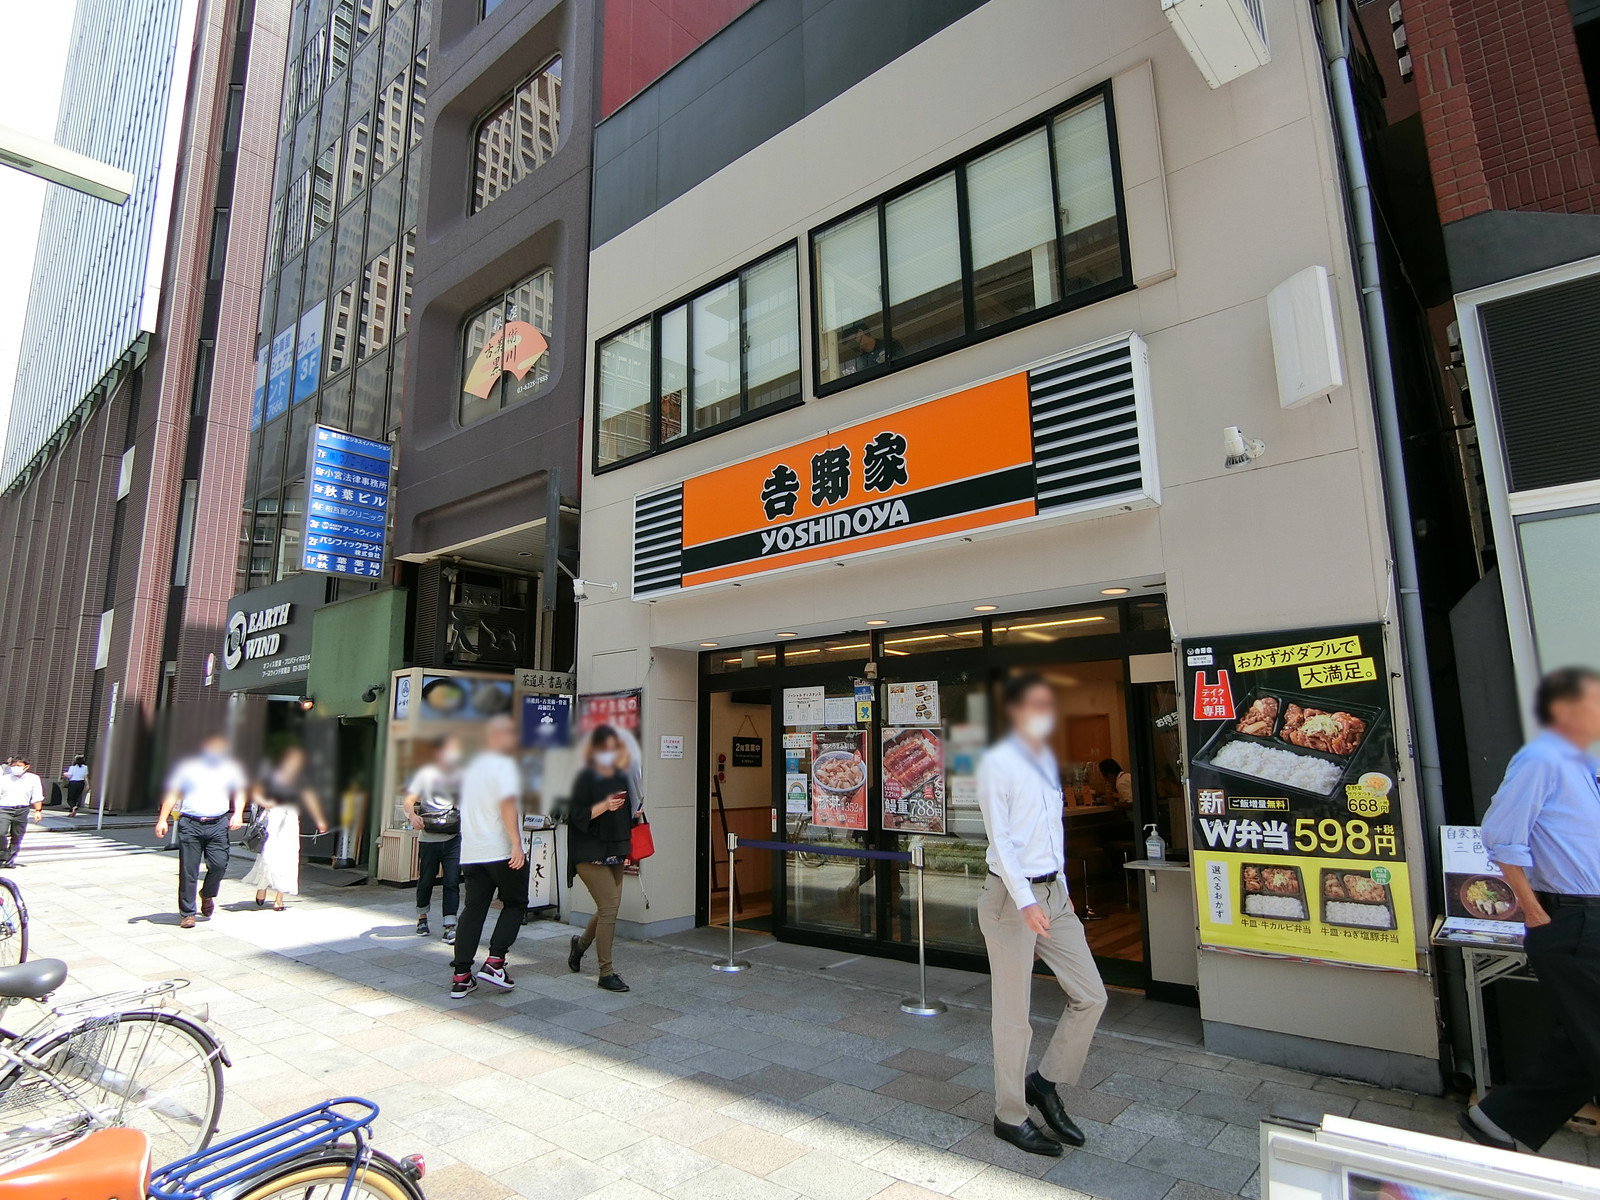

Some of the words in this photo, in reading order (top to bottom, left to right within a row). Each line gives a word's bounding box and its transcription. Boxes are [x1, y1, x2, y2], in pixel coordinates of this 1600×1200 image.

[300, 352, 318, 381] 3F
[317, 449, 327, 458] 7F
[325, 469, 388, 490] 小宮法律事務所
[759, 431, 909, 521] 吉野家
[312, 502, 323, 510] 4F
[324, 485, 387, 507] 秋葉ビル
[760, 499, 910, 554] YOSHINOYA
[308, 537, 319, 546] 2F
[320, 537, 382, 552] パシフィックランド
[355, 550, 380, 559] 株式会社
[307, 556, 317, 565] 1F
[248, 603, 290, 633] EARTH
[246, 634, 280, 659] WIND
[1237, 640, 1357, 669] おかずがダブルで
[1302, 662, 1373, 686] 大満足。
[1202, 688, 1225, 697] テイク
[1202, 697, 1225, 705] アウト
[1203, 705, 1226, 717] 専用
[1200, 790, 1223, 814] 新
[1231, 799, 1286, 810] ご飯増量無料
[1199, 818, 1290, 851] W弁当
[1453, 842, 1485, 854] 三色
[1211, 865, 1224, 919] 選べるおかず
[1241, 919, 1312, 935] 牛皿・牛カルビ弁当
[1320, 927, 1399, 944] 牛皿・ねぎ塩豚弁当
